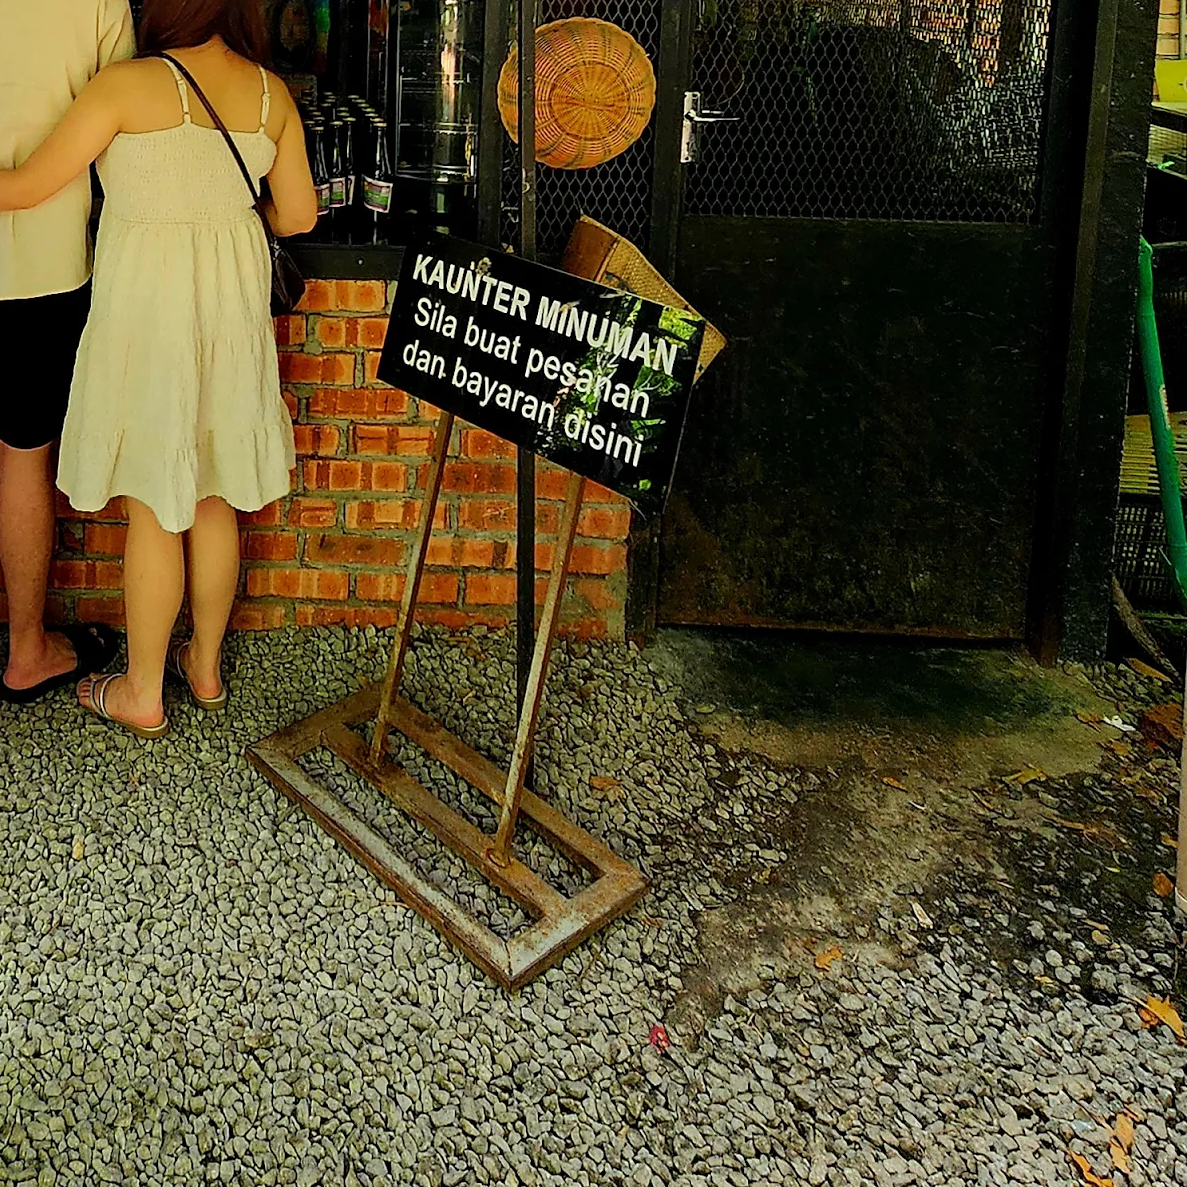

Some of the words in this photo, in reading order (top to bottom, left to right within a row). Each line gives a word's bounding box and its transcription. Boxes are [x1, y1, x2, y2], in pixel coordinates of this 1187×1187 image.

[413, 253, 531, 321] KAUNTER
[535, 295, 678, 377] MINUMAN
[414, 297, 458, 339] Sila
[464, 316, 522, 364] buat
[524, 347, 650, 418] pesanan
[403, 339, 447, 380] dan
[451, 358, 557, 430] bayaran
[563, 406, 644, 467] disini
